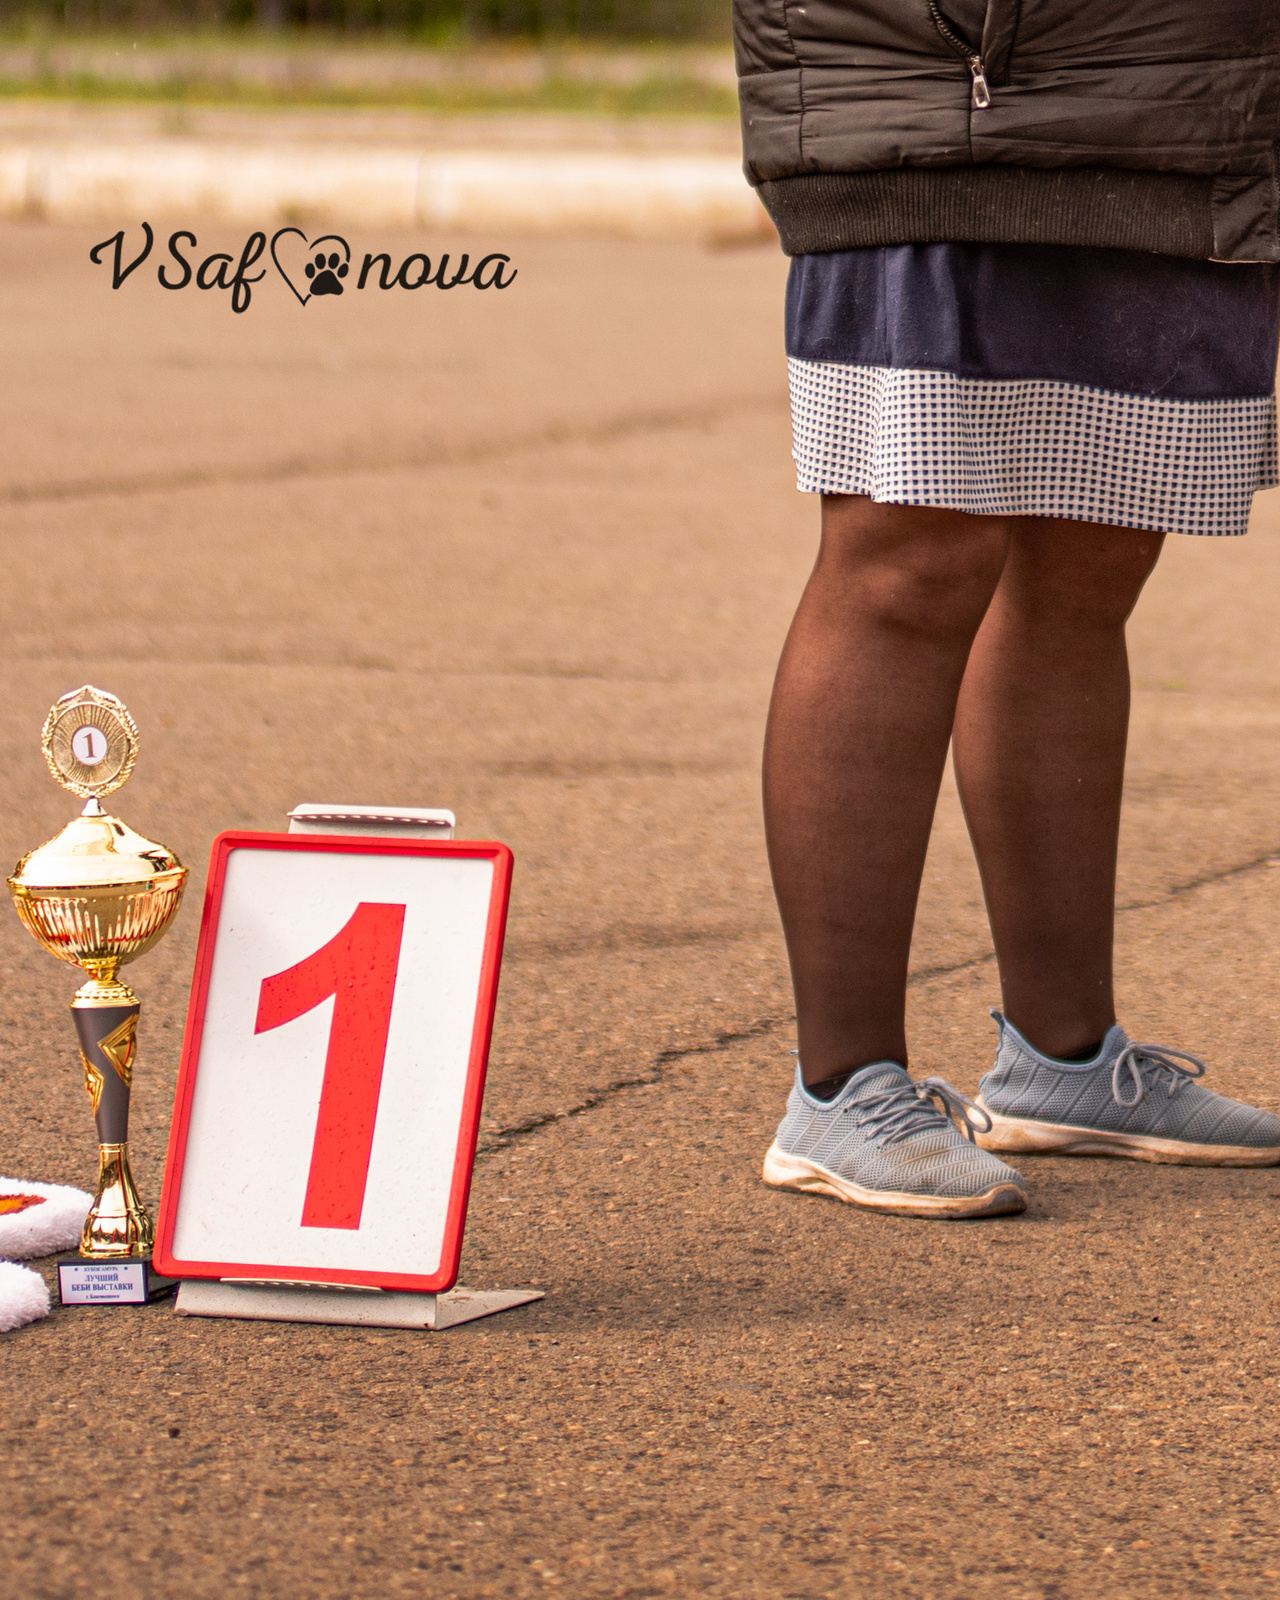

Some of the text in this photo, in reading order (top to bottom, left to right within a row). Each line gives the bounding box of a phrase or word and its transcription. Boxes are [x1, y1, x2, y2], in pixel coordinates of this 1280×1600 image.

[83, 732, 97, 759] 1
[254, 901, 407, 1231] 1
[85, 1273, 119, 1282] ЛУЧШИЙ
[71, 1283, 133, 1292] БЕБИ ВЫСТАВКИ
